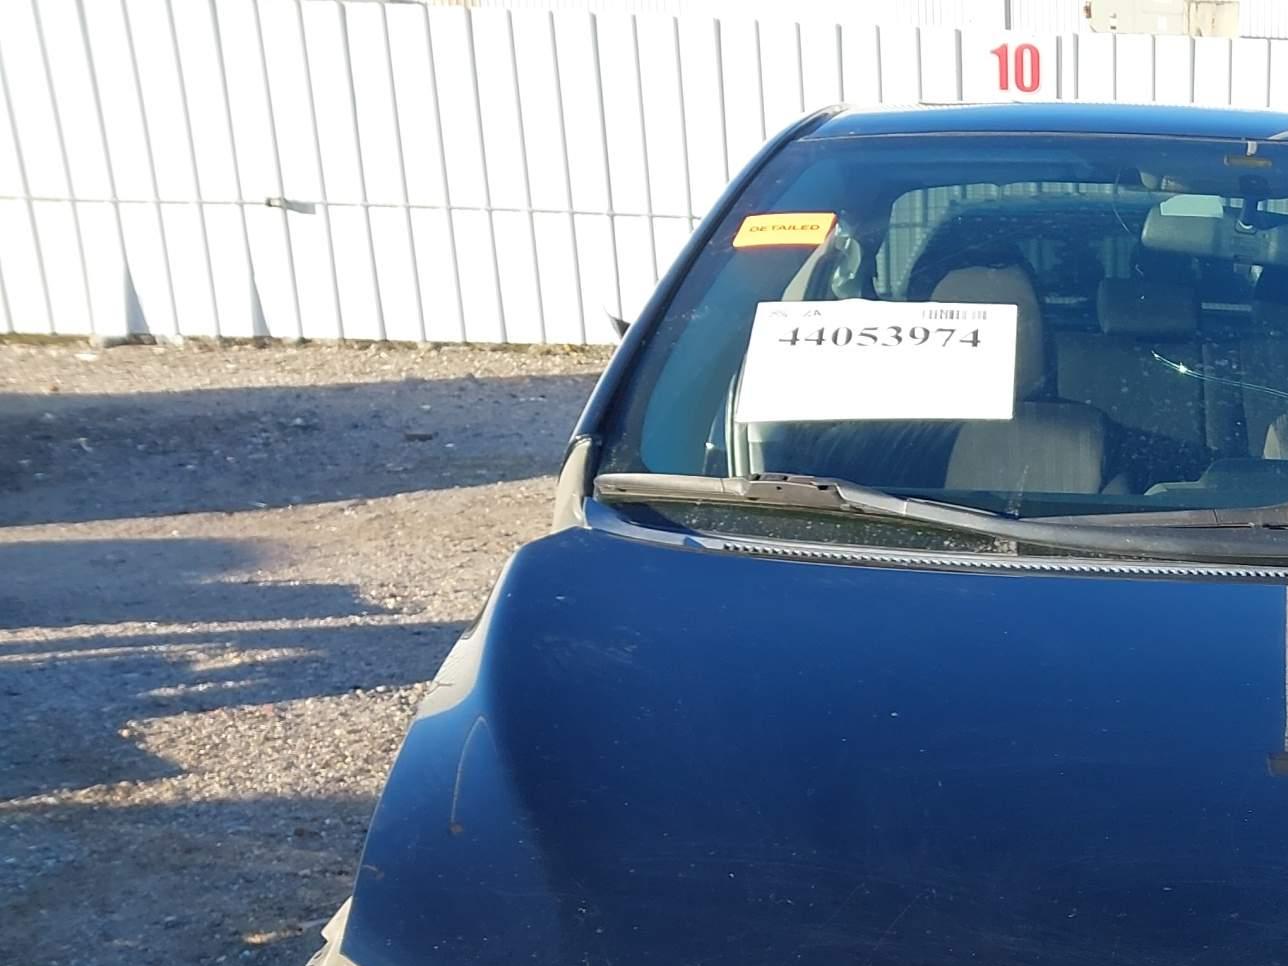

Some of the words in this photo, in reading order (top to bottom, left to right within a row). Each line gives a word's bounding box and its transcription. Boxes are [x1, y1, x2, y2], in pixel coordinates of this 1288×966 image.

[990, 43, 1040, 93] 10
[749, 224, 821, 232] DETAILED
[778, 325, 982, 348] 44053974
